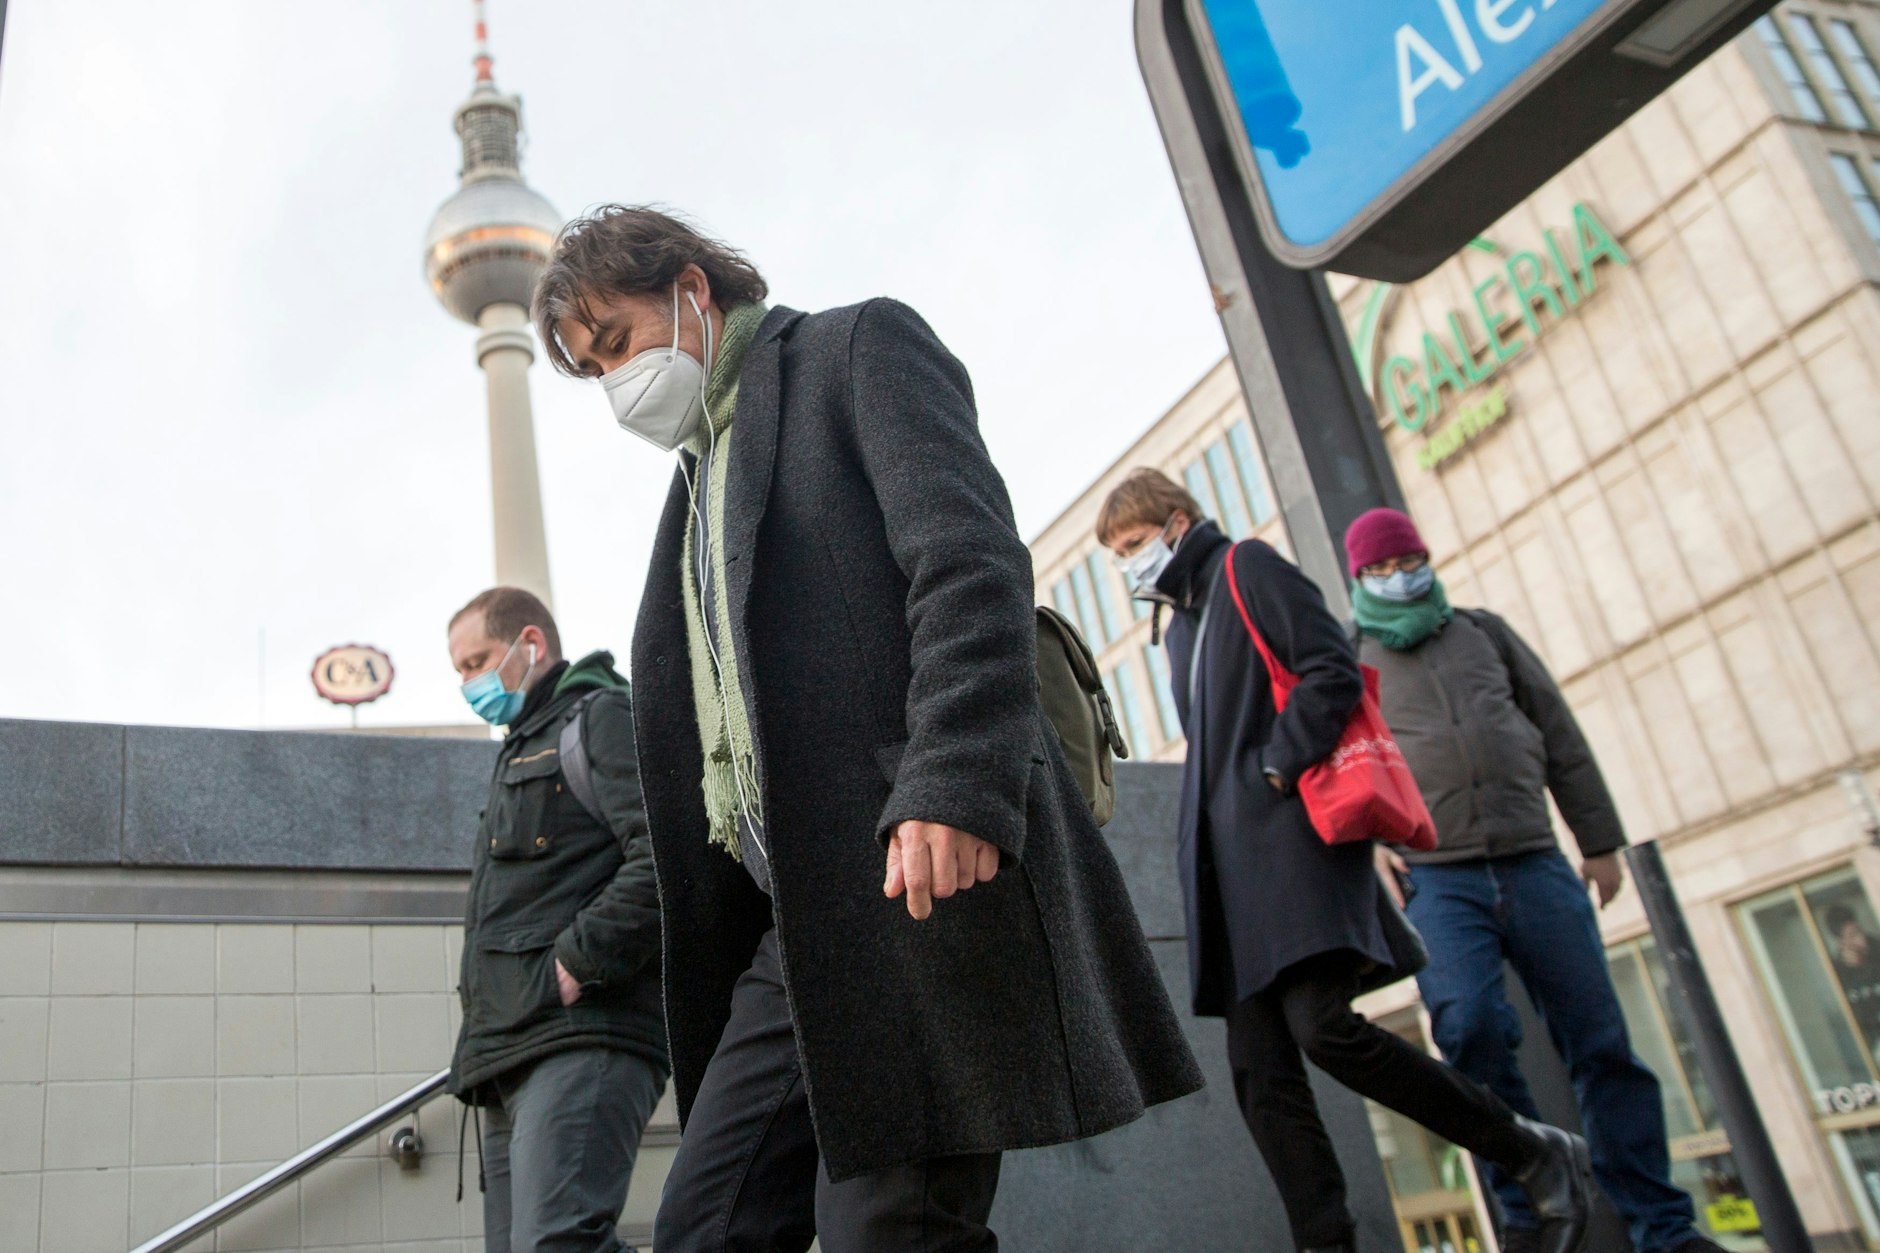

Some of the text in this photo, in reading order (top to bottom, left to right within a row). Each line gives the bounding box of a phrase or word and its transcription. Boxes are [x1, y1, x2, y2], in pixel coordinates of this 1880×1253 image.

[1394, 0, 1557, 132] Ale
[1381, 202, 1629, 432] GALERIA
[325, 657, 381, 685] C&A
